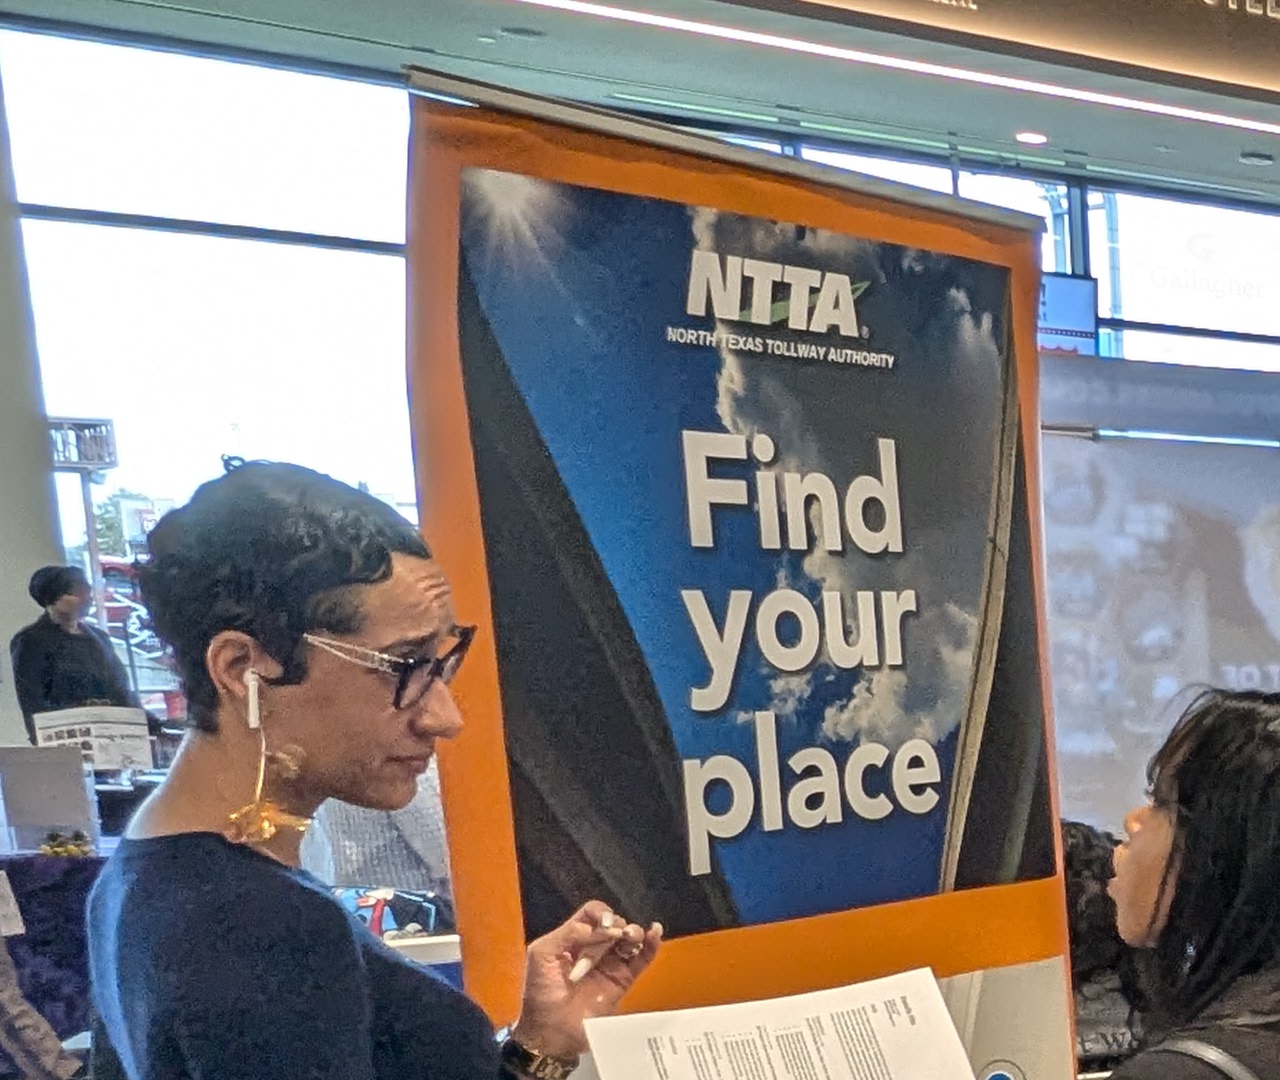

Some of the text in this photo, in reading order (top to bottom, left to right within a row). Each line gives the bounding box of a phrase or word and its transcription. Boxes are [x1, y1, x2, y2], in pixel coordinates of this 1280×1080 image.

[666, 326, 895, 369] NORTH TEXAS TOLLWAY AUTHORITY
[687, 250, 860, 338] NTTA
[681, 430, 903, 555] Find
[681, 587, 917, 712] your
[681, 710, 942, 876] place
